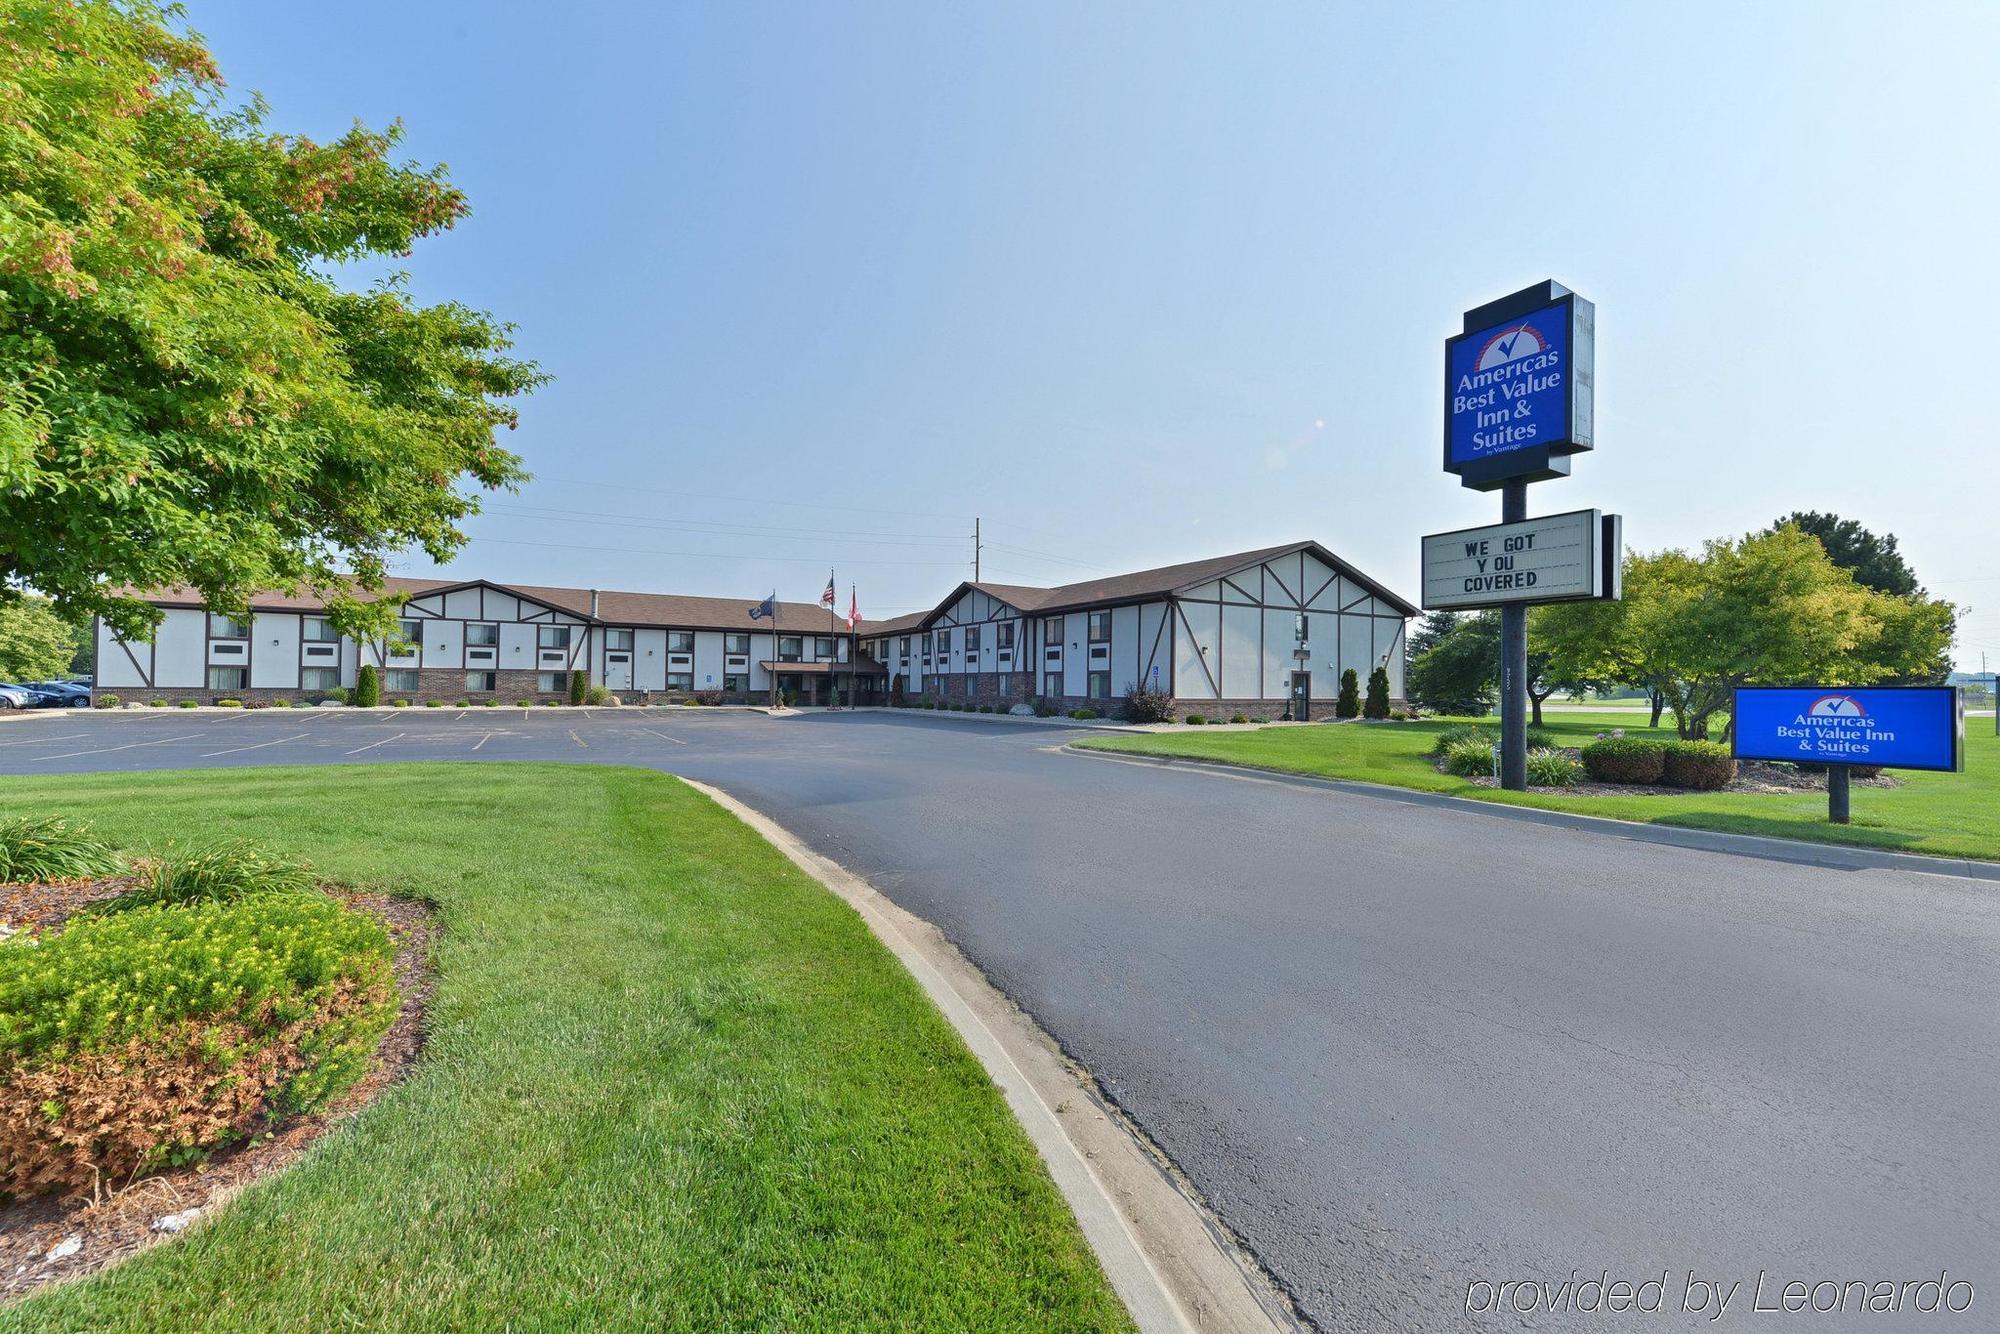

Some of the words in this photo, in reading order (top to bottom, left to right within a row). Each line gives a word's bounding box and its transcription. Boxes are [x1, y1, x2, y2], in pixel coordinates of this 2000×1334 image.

[1457, 350, 1559, 393] Americas
[1454, 389, 1495, 414] Best
[1501, 372, 1560, 400] Value
[1477, 410, 1509, 429] Inn
[1513, 399, 1532, 419] &
[1473, 423, 1537, 451] Suites
[1494, 442, 1522, 454] Vantage
[1465, 541, 1489, 557] WE
[1504, 534, 1535, 551] GOT
[1464, 571, 1537, 592] COVERED
[1794, 714, 1875, 728] Americas
[1777, 726, 1810, 738] Best
[1815, 727, 1863, 740] Value
[1866, 730, 1895, 741] Inn
[1798, 740, 1812, 751] &
[1818, 740, 1870, 754] Suites
